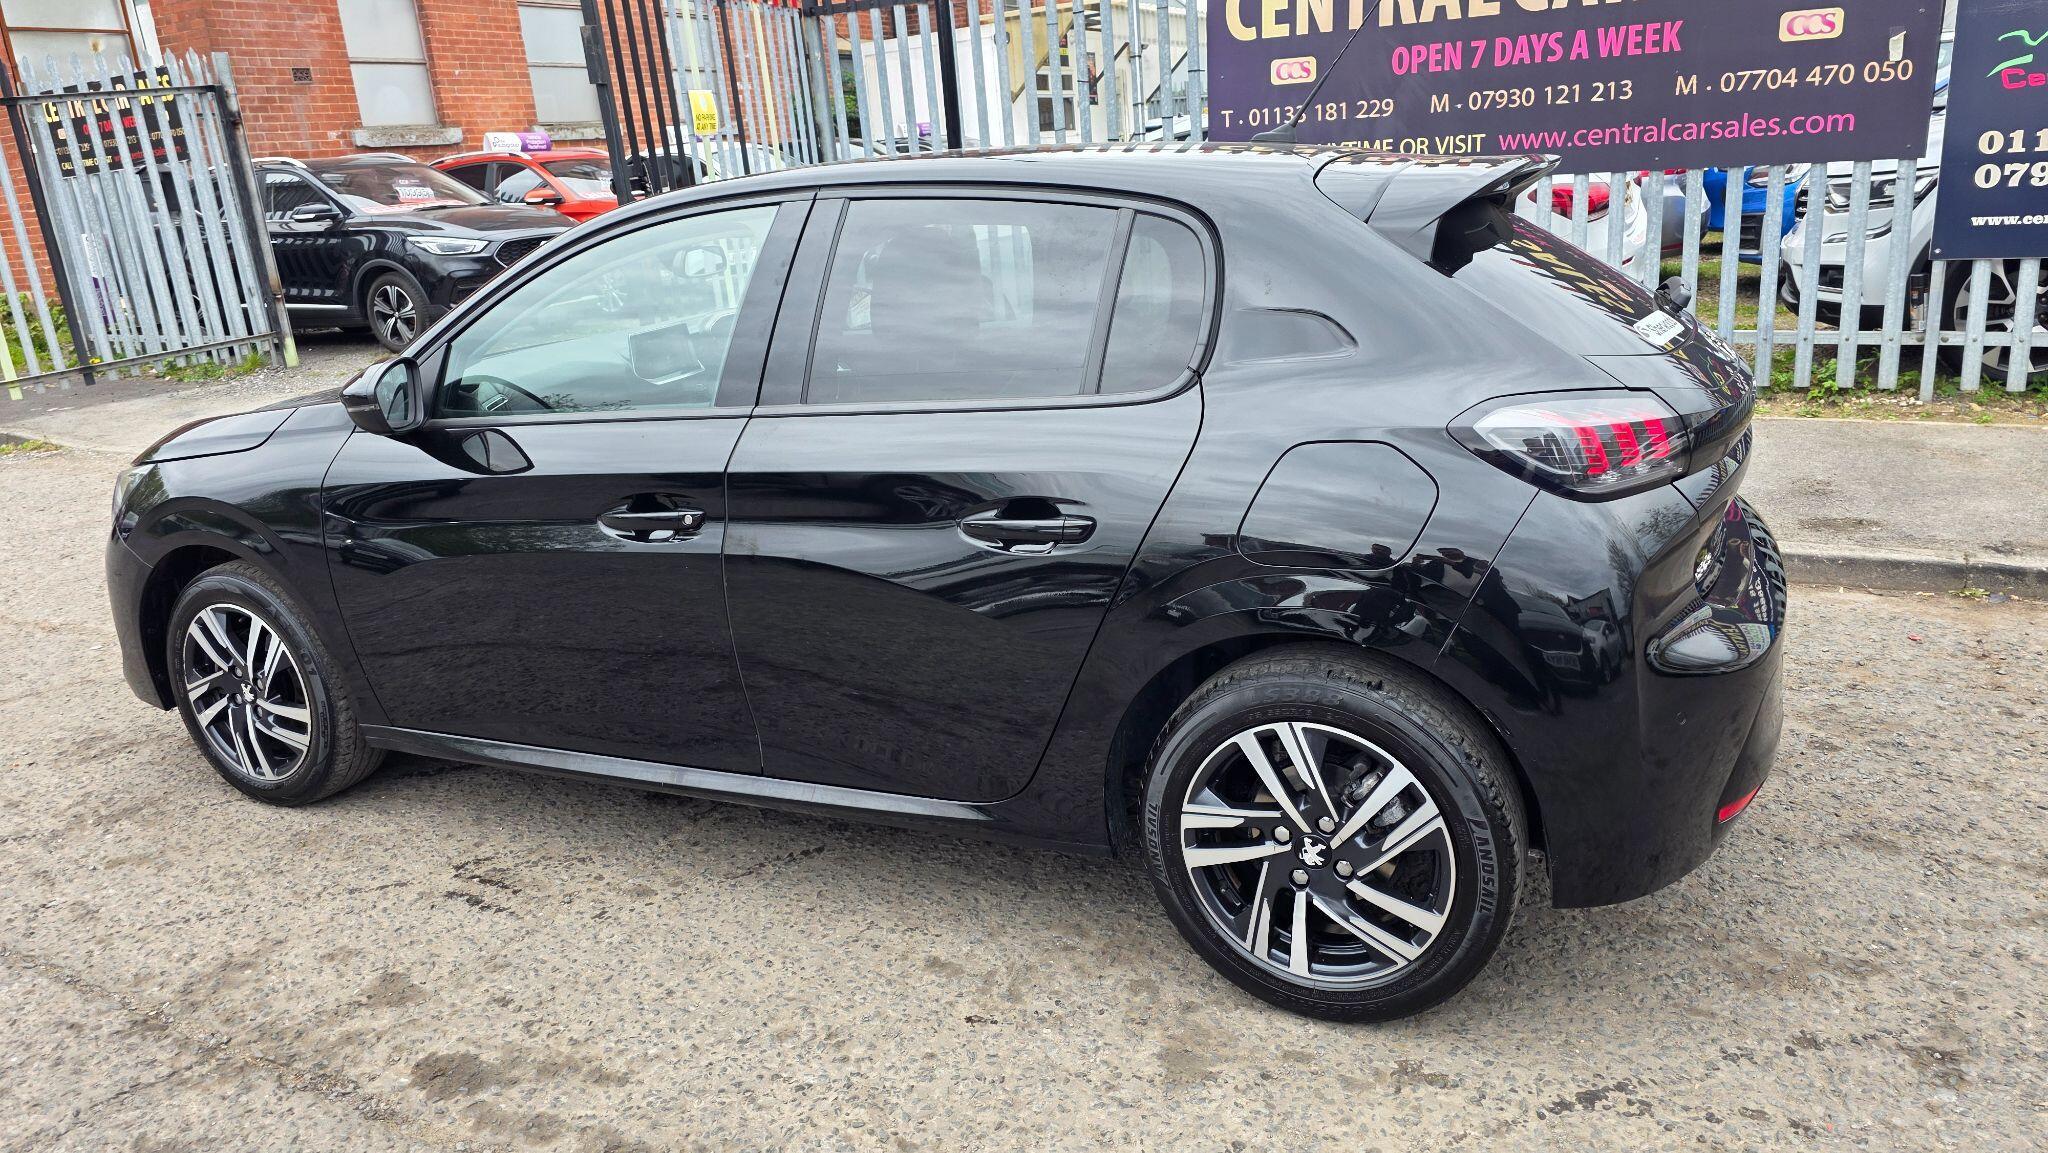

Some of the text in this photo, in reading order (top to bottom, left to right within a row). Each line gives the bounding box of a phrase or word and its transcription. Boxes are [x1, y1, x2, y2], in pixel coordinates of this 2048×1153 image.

[1391, 20, 1684, 75] OPEN 7 DAYS A WEEK
[1315, 102, 1347, 122] 181
[1355, 99, 1394, 119] 229
[1468, 87, 1535, 111] 07930
[1544, 83, 1580, 104] 121
[1590, 79, 1633, 102] 213
[1720, 67, 1797, 93] 07704
[1806, 63, 1855, 86] 470
[1863, 59, 1913, 83] 050
[2001, 68, 2048, 89] Ce
[1400, 137, 1429, 154] OR
[1435, 133, 1486, 155] VISIT
[1498, 112, 1855, 151] www.centralcarsales.com
